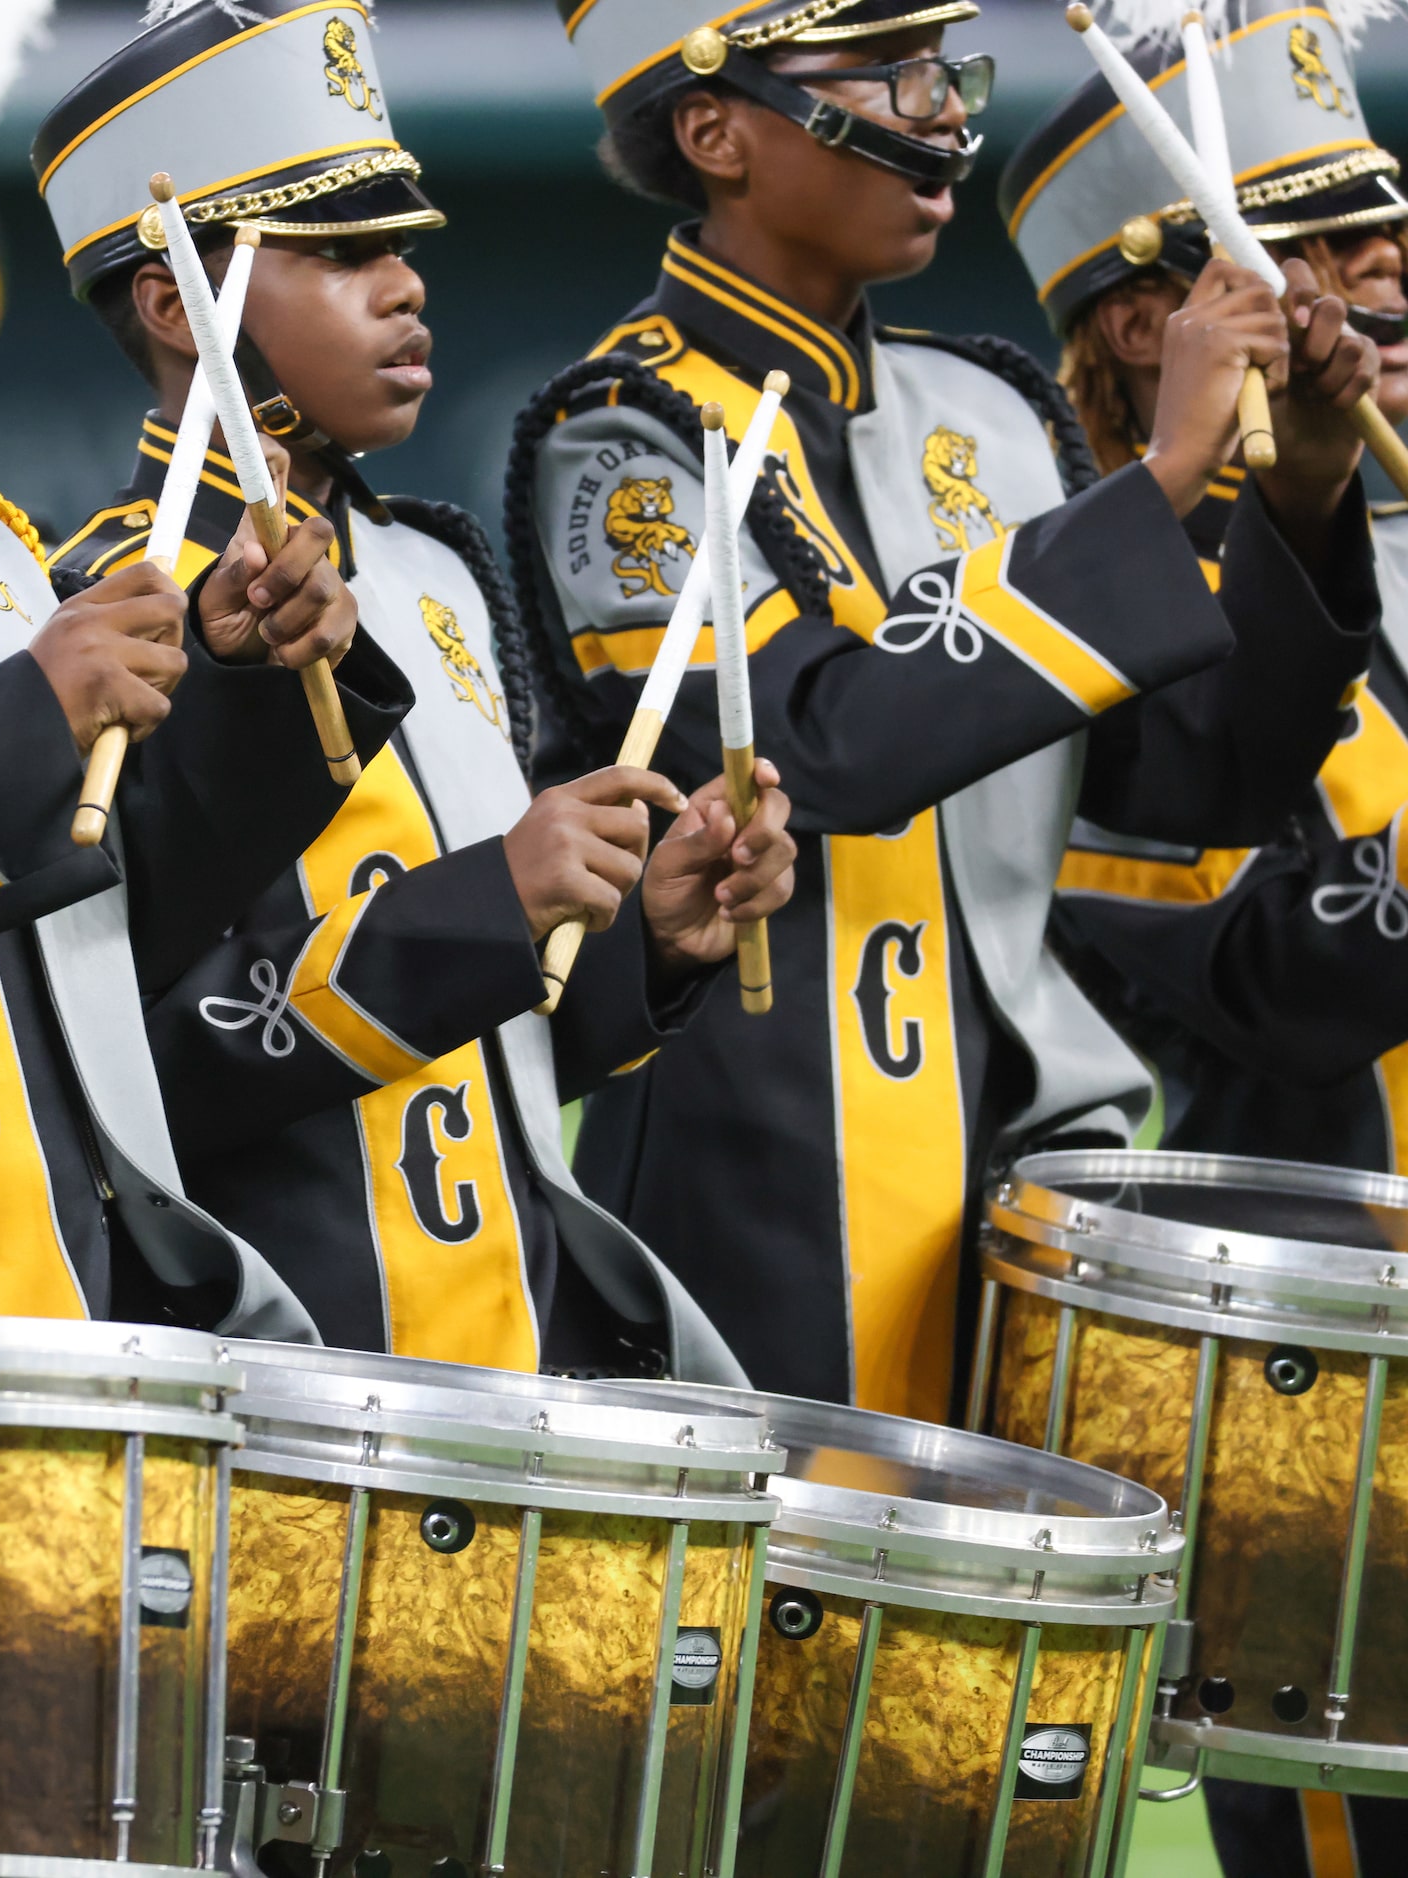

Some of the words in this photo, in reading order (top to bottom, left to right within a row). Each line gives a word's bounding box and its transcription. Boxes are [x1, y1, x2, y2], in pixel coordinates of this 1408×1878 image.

[569, 475, 601, 575] SOUTH
[850, 921, 929, 1082] C
[393, 1081, 484, 1244] C
[1023, 1749, 1085, 1761] CHAMPIONSHIP
